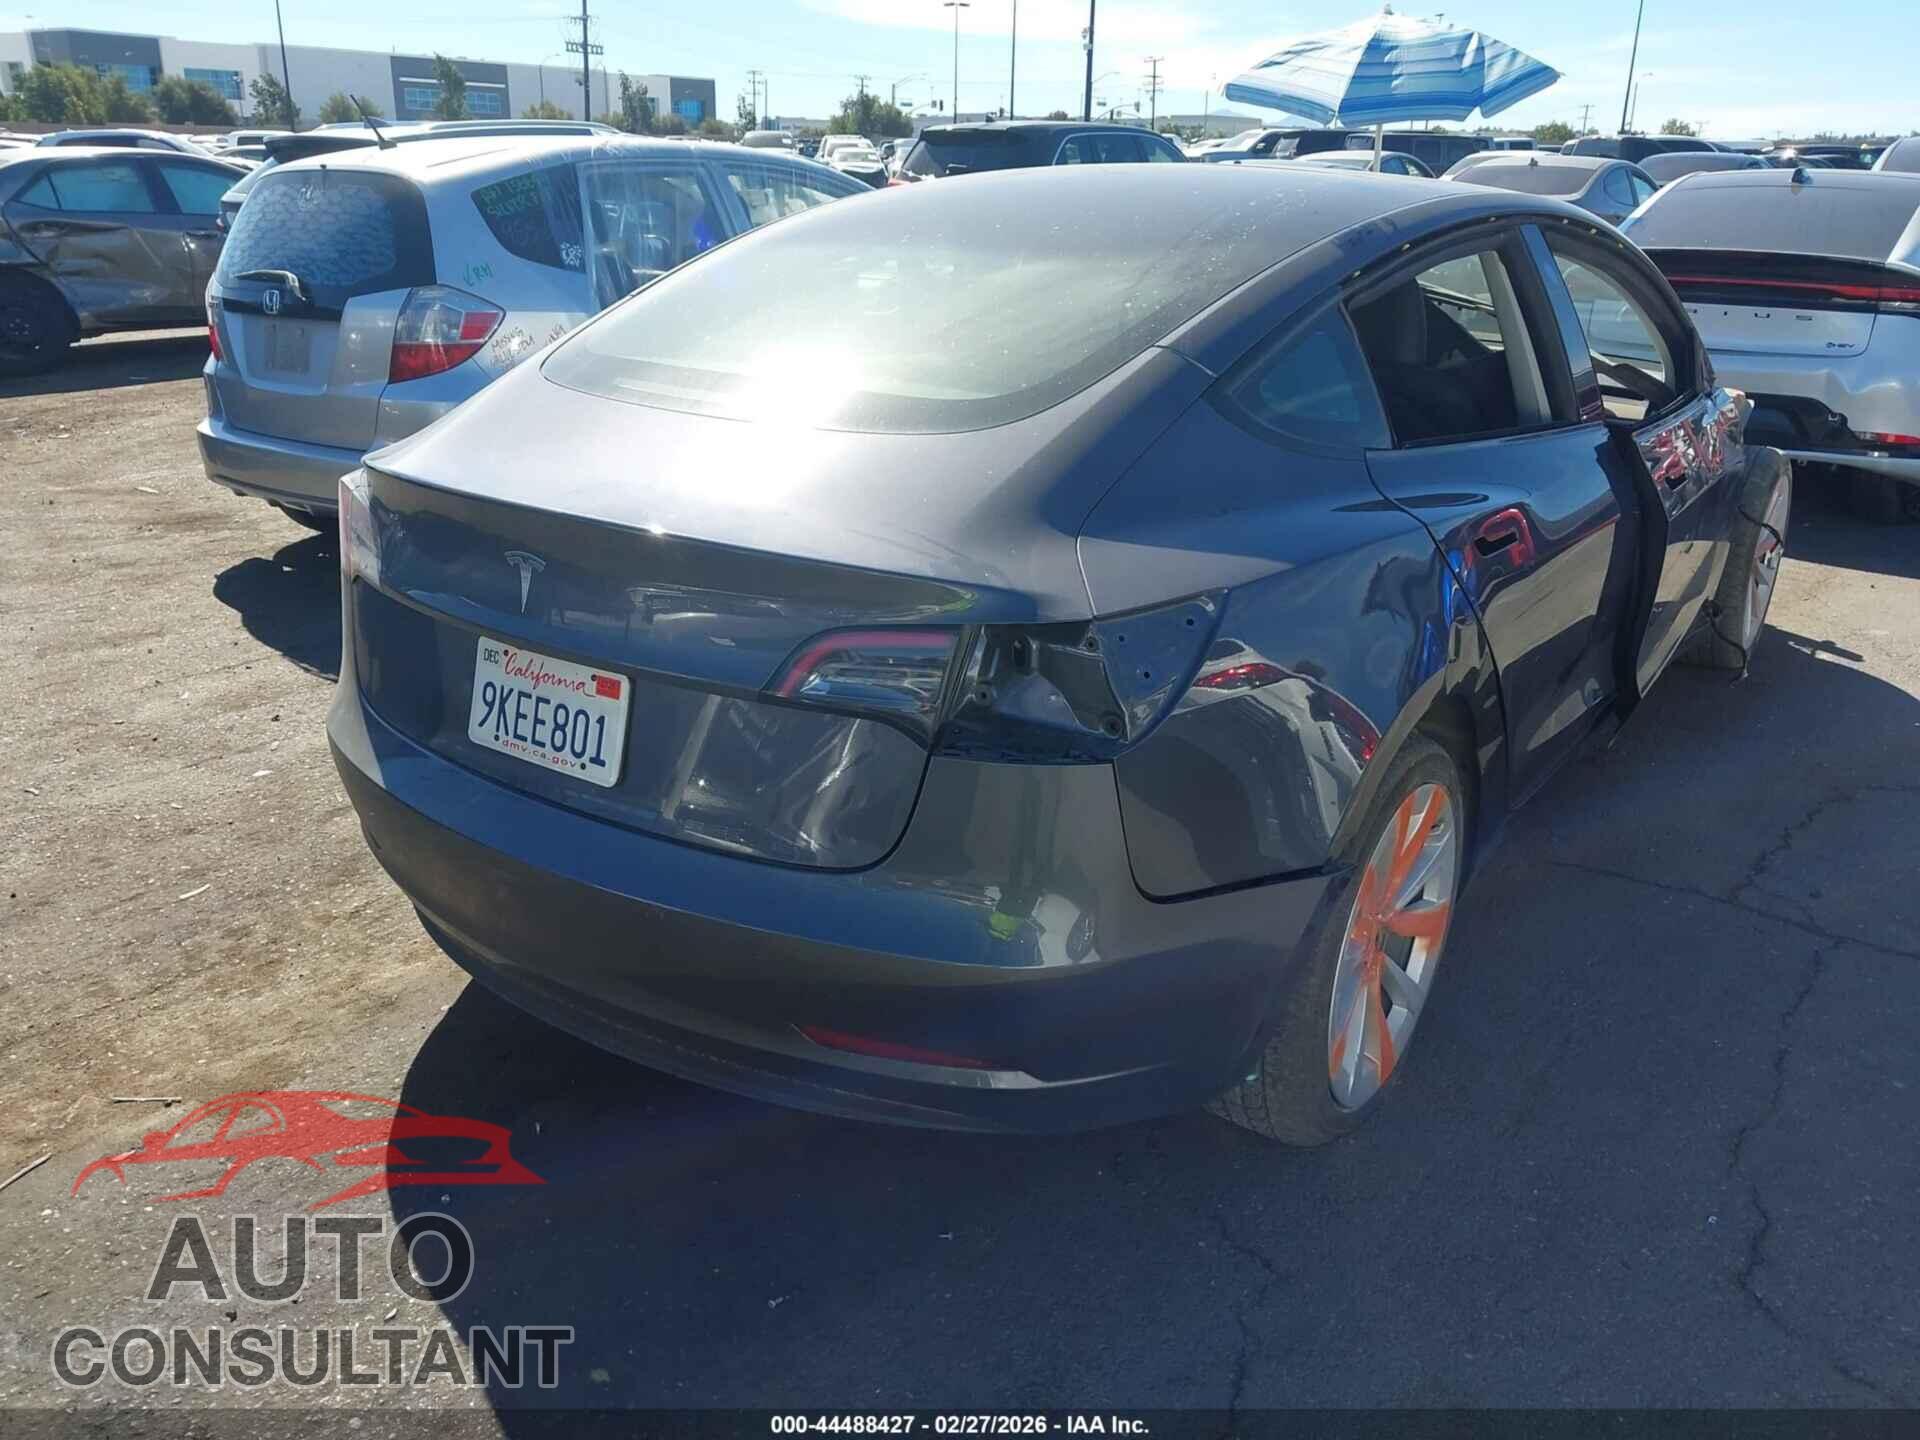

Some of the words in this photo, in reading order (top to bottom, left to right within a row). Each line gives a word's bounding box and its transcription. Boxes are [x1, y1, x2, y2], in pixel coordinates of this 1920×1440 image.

[483, 647, 499, 665] DEC
[504, 652, 597, 698] California
[478, 681, 607, 768] 9KEE801
[502, 739, 577, 769] dmv.ca.gov
